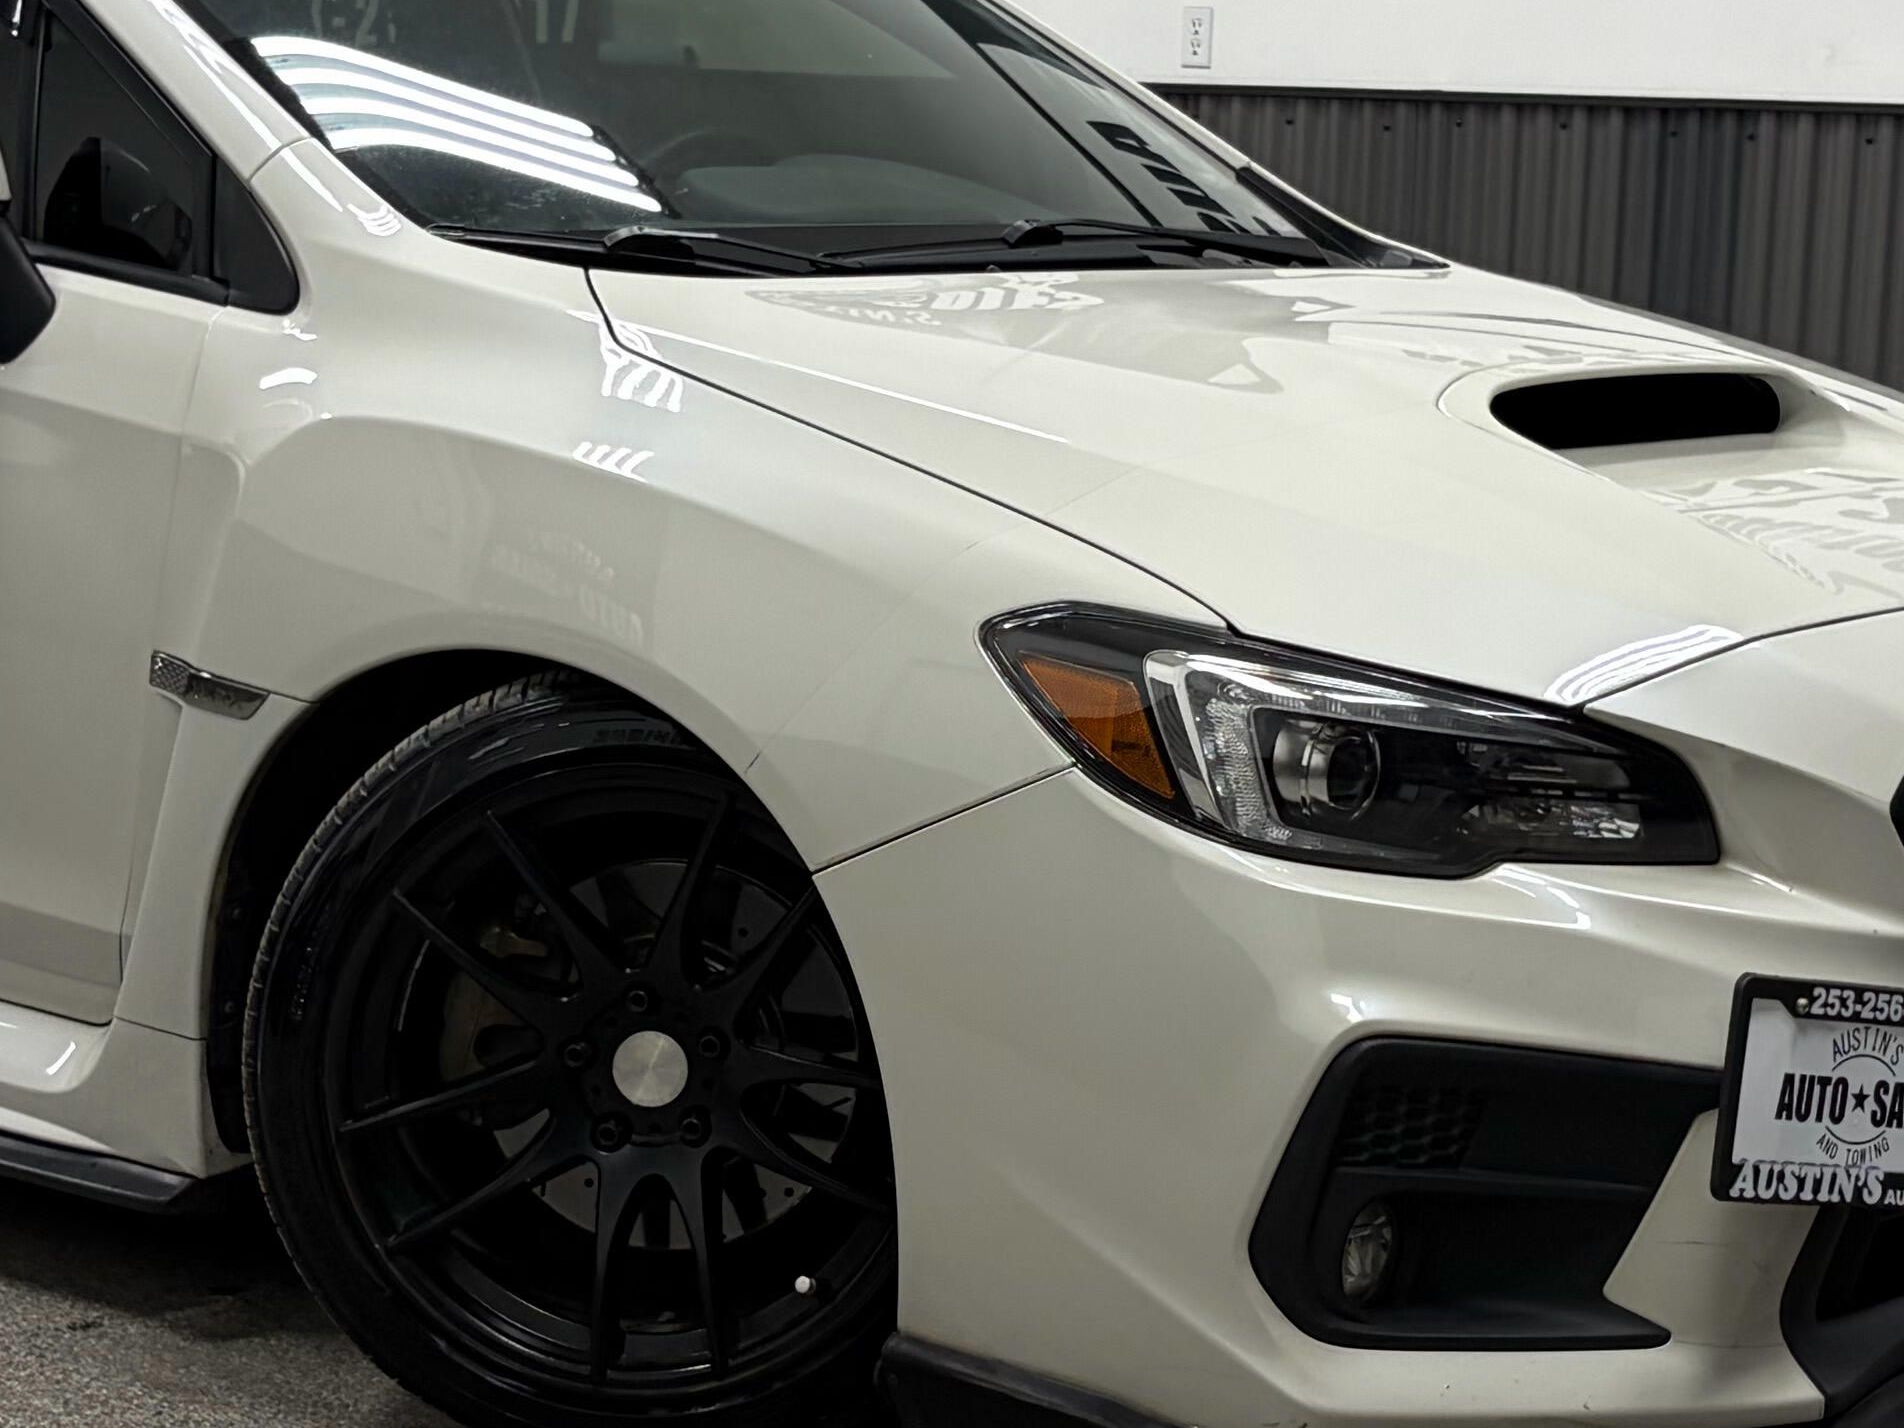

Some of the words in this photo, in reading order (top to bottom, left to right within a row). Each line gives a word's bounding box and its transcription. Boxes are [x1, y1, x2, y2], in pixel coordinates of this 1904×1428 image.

[1831, 1025, 1904, 1066] AUSTIN'S
[1774, 1072, 1850, 1125] AUTO
[1815, 1134, 1839, 1160] AND
[1845, 1136, 1890, 1168] TOWING
[1728, 1158, 1885, 1205] AUSTIN'S
